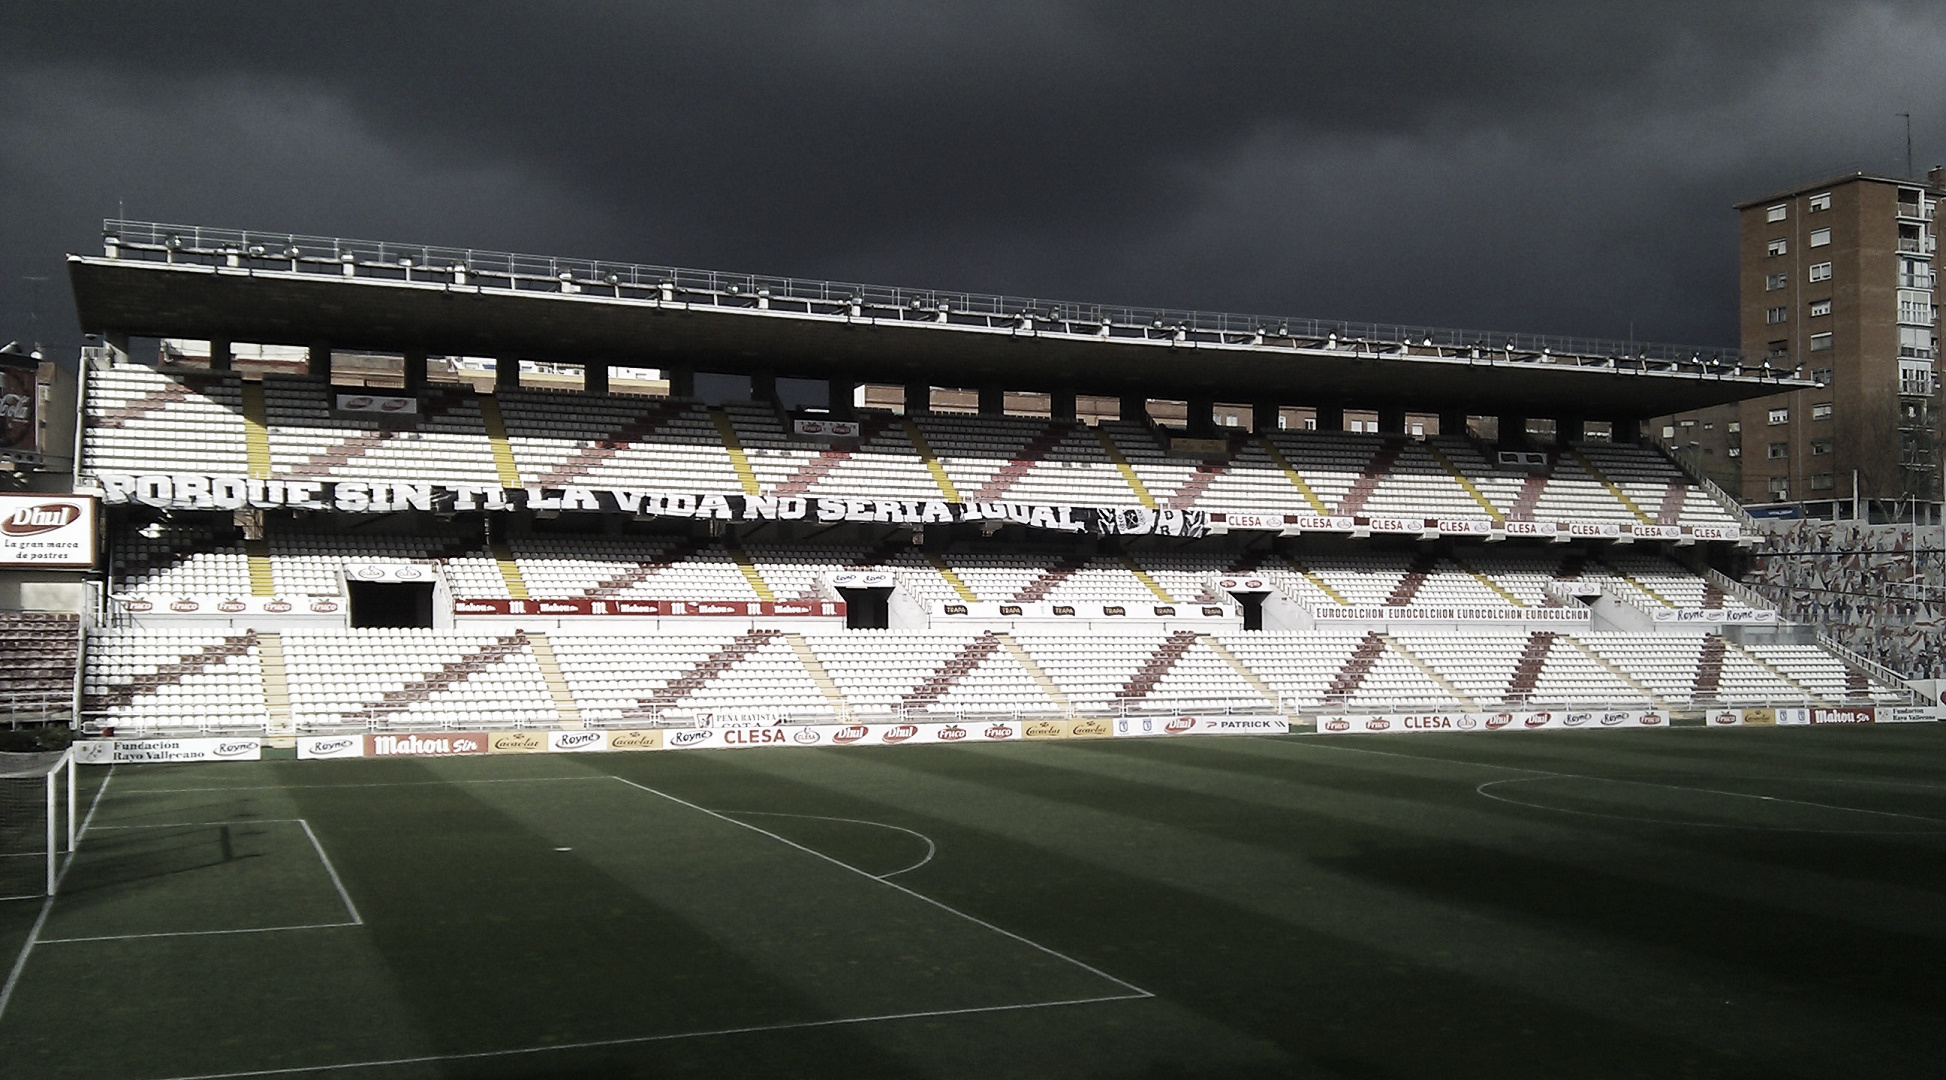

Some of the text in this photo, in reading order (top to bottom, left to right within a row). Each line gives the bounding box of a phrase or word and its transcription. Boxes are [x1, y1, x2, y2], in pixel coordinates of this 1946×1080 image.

[334, 482, 431, 512] SIN
[527, 487, 599, 510] LA
[611, 491, 733, 519] VIDA
[743, 494, 806, 520] NO
[11, 506, 70, 526] Dhul
[1229, 516, 1262, 527] CLESA
[1300, 517, 1332, 528] CLESA
[1371, 519, 1403, 530] CLESA
[1439, 521, 1470, 532] CLESA
[1507, 523, 1537, 534] CLESA
[1571, 525, 1600, 535] CLESA
[1633, 526, 1662, 537] CLESA
[1694, 528, 1722, 538] CLESA
[5, 539, 16, 548] La
[31, 552, 68, 560] postres
[1317, 608, 1588, 620] EUROCOLCHON EUROCOLCHON EUROCOLCHON EUROCOLCHON
[1815, 709, 1855, 723] Mahou
[1327, 721, 1349, 730] Fruco
[1367, 720, 1388, 729] Fruco
[1404, 716, 1451, 728] CLESA
[676, 731, 707, 743] Royne
[724, 729, 786, 744] CLESA
[838, 727, 863, 738] Dhul
[888, 726, 913, 738] Dhul
[939, 729, 965, 739] Fruco
[986, 728, 1012, 738] Fruco
[561, 732, 595, 745] Royne
[114, 741, 179, 750] Fundación
[315, 740, 347, 752] Royne
[374, 735, 450, 755] Mahou
[113, 751, 205, 762] Rayo Vallecano
